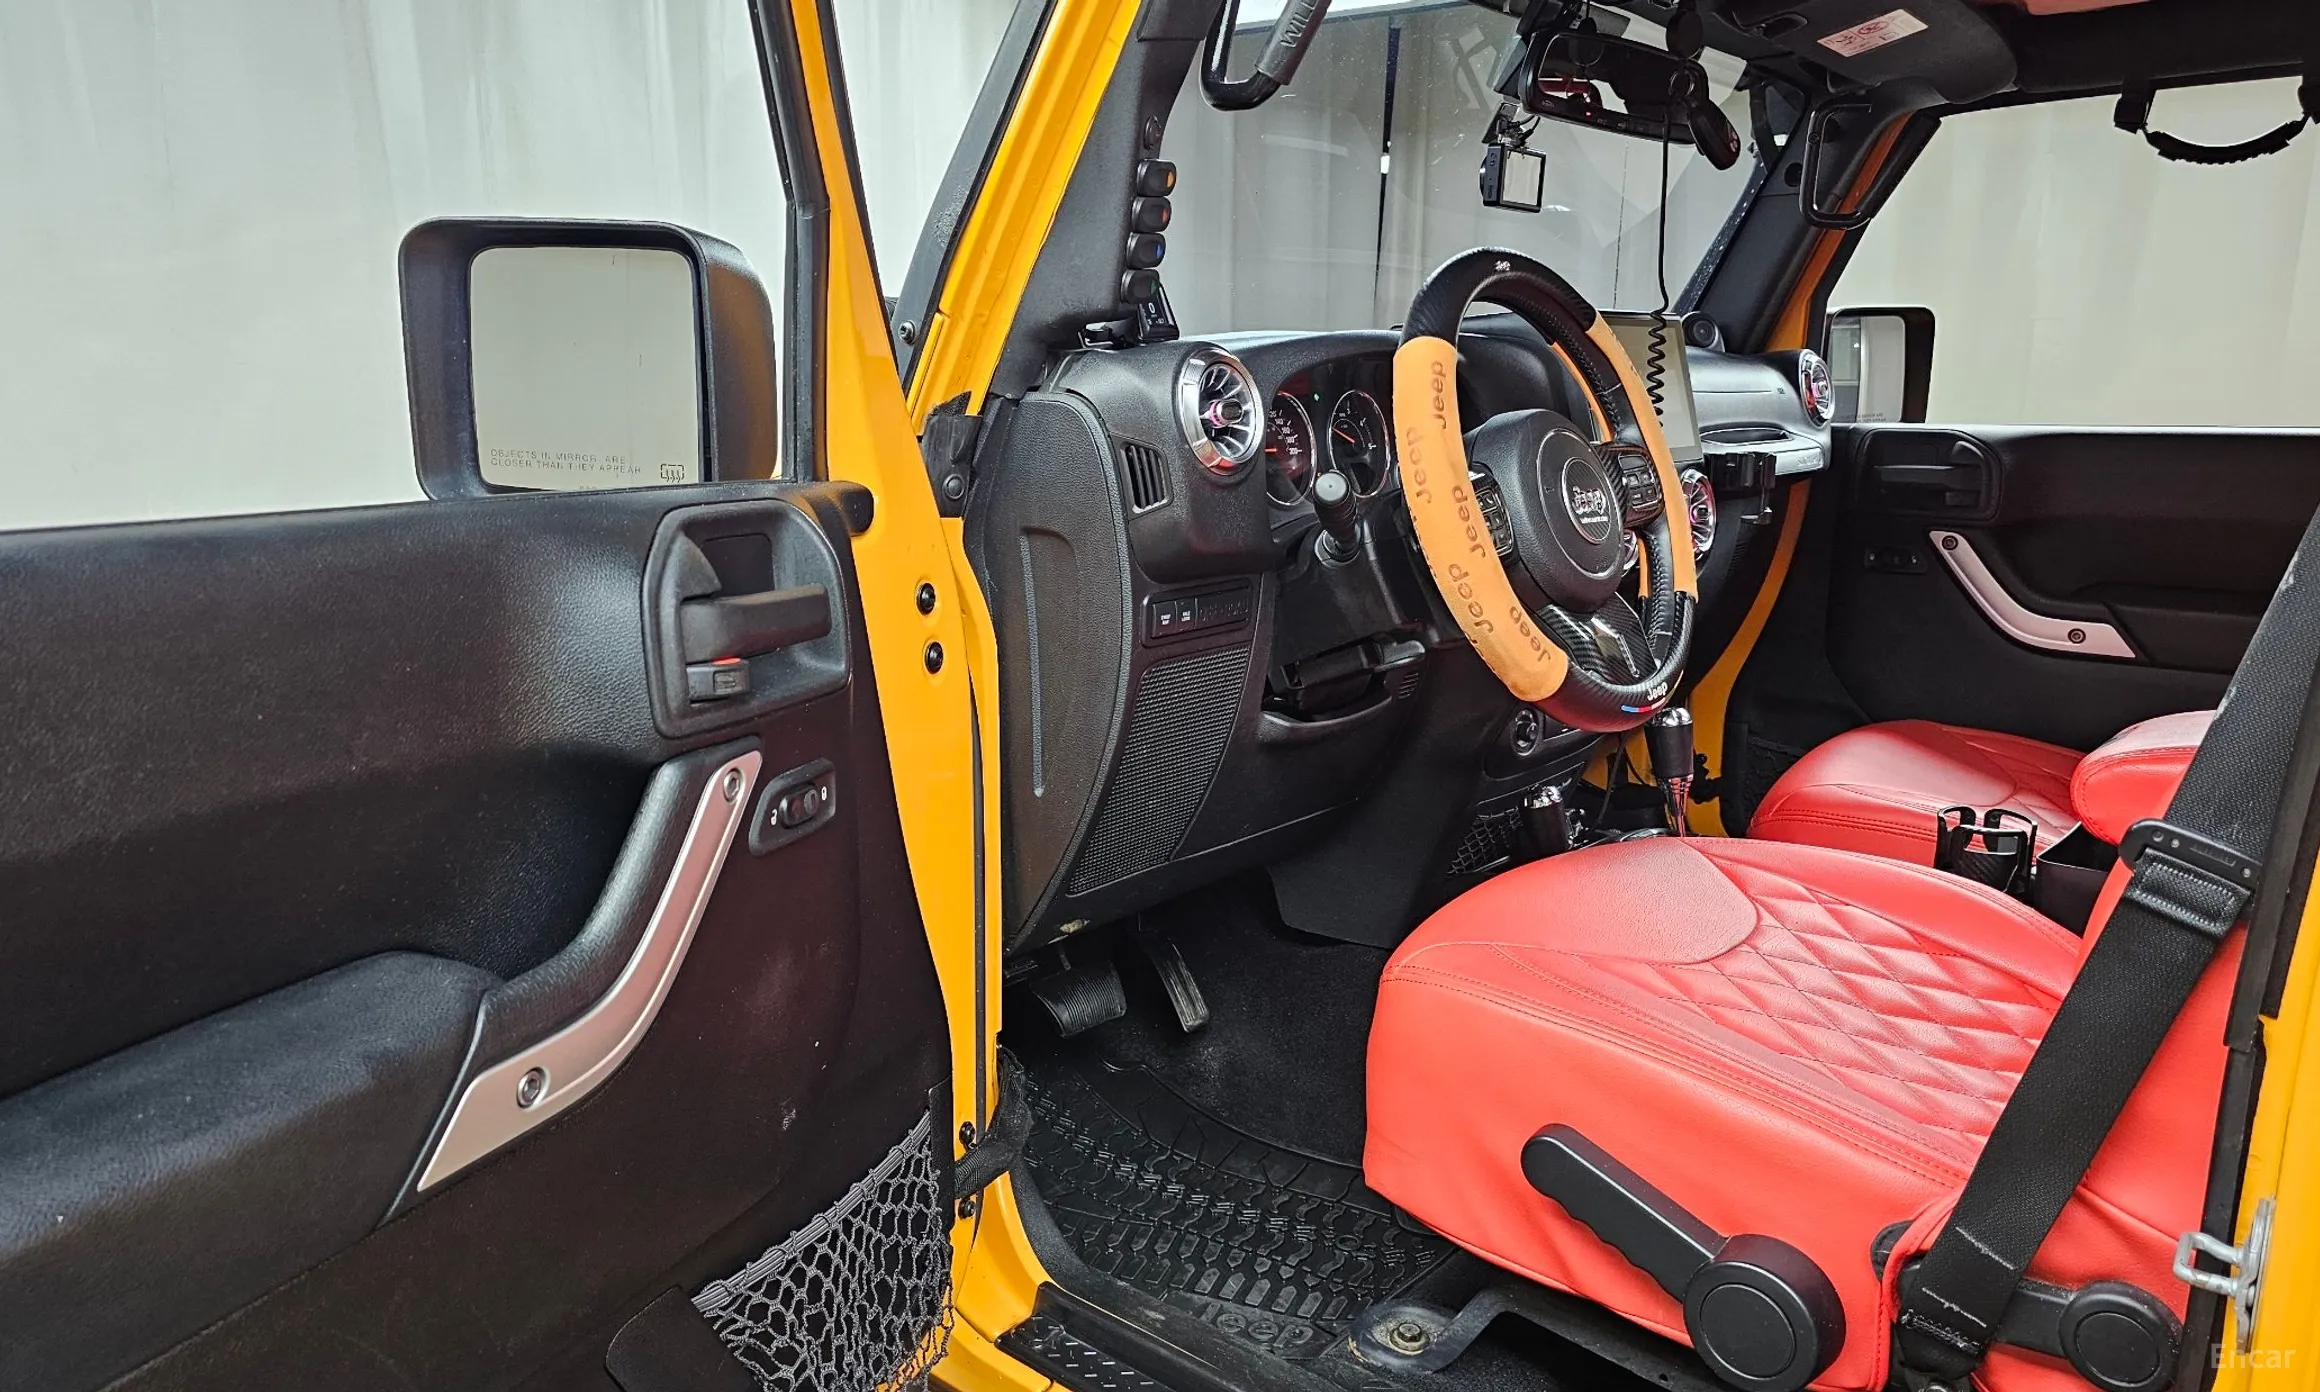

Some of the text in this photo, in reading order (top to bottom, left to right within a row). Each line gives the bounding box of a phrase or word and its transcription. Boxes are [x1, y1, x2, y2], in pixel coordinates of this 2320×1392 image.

[1431, 360, 1447, 430] Jeep
[490, 449, 537, 460] OBJECTS
[556, 452, 597, 463] MIRROR
[605, 455, 626, 465] ARE
[490, 458, 641, 475] CLOSER THAN THEY APPEAR
[1406, 427, 1433, 504] Jeep
[1452, 485, 1486, 559] Jeep
[1448, 563, 1494, 634] Jeep
[1509, 606, 1551, 662] Jeep
[1647, 681, 1668, 701] Jeep
